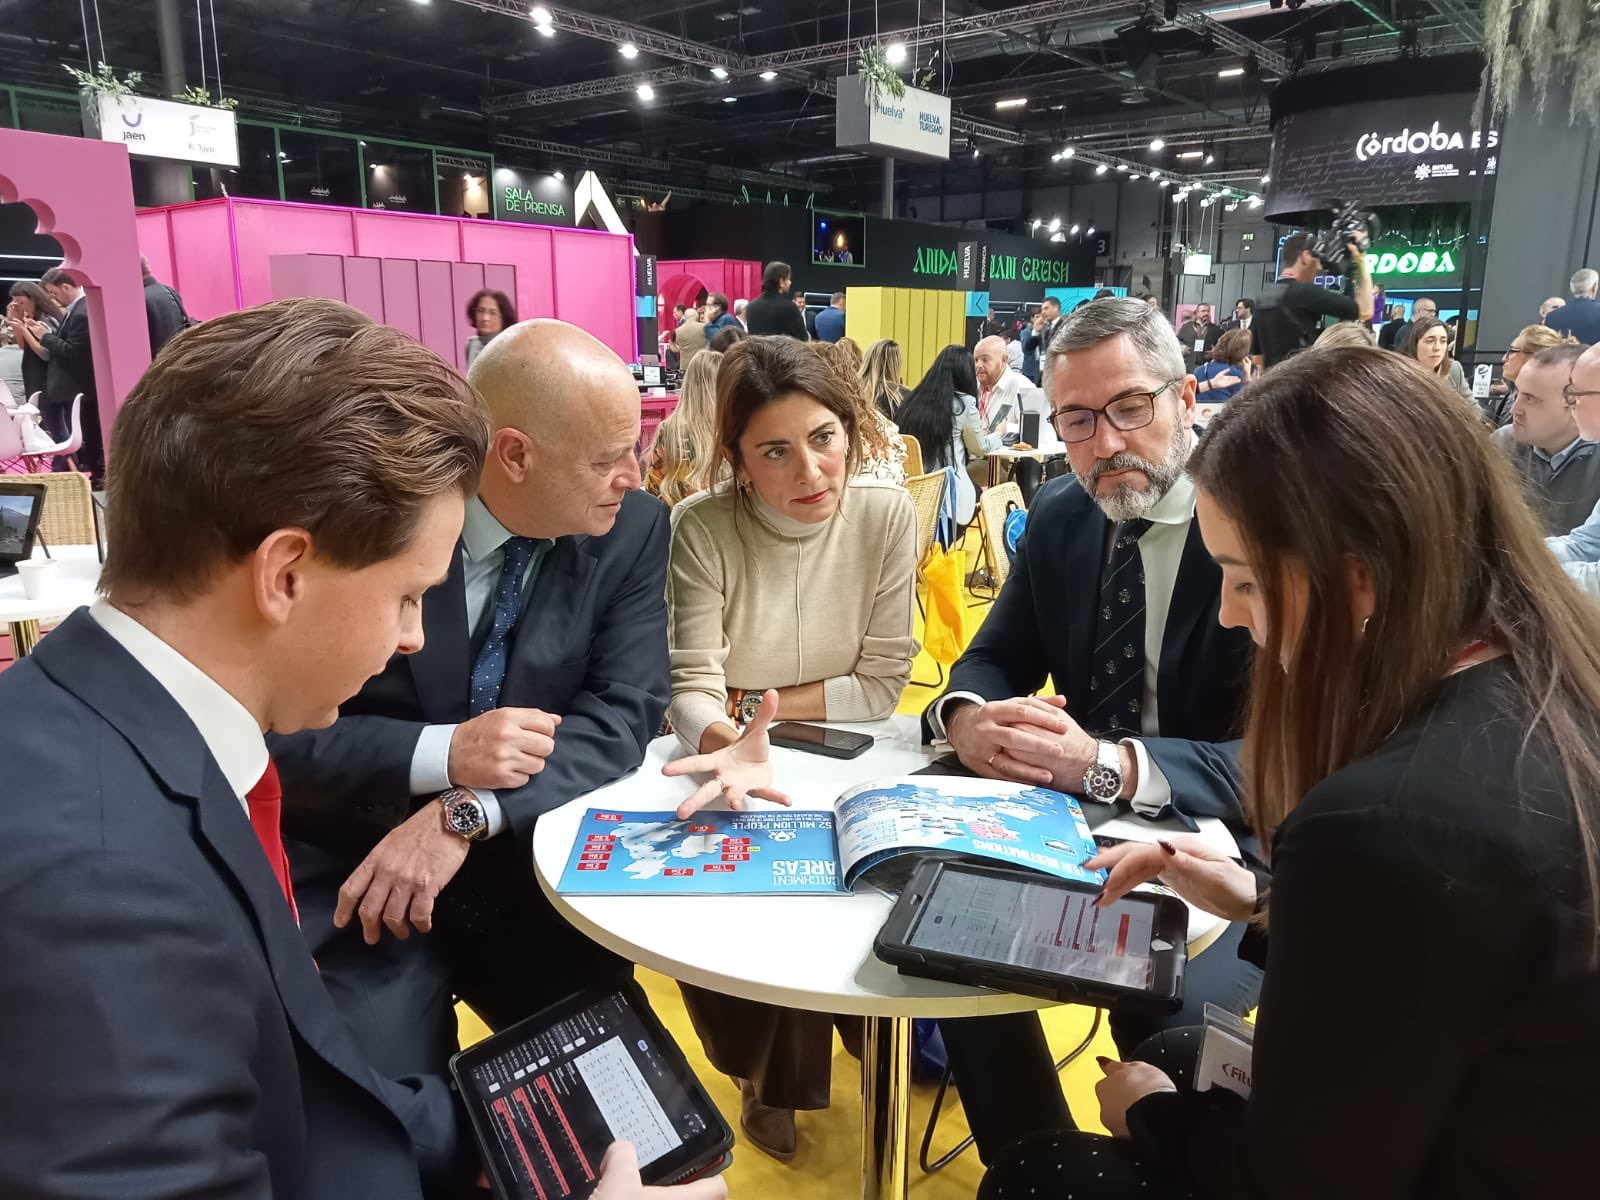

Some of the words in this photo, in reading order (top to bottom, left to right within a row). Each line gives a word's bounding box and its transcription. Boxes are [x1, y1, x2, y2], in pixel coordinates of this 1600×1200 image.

[919, 111, 940, 125] HUELVA
[919, 121, 943, 135] TURISMO
[504, 186, 533, 201] SALA
[505, 199, 521, 213] DE
[524, 201, 566, 217] PRENSA
[1096, 239, 1106, 254] 3
[962, 245, 972, 279] HUELVA
[980, 245, 988, 283] PROVINCIA
[1364, 250, 1456, 274] RDOBA
[1021, 256, 1070, 284] CRUSH
[731, 822, 770, 831] PEOPLE
[773, 821, 816, 830] MILLION
[818, 821, 832, 829] 52
[772, 860, 836, 876] AREAS
[772, 875, 839, 886] CATCHMENT
